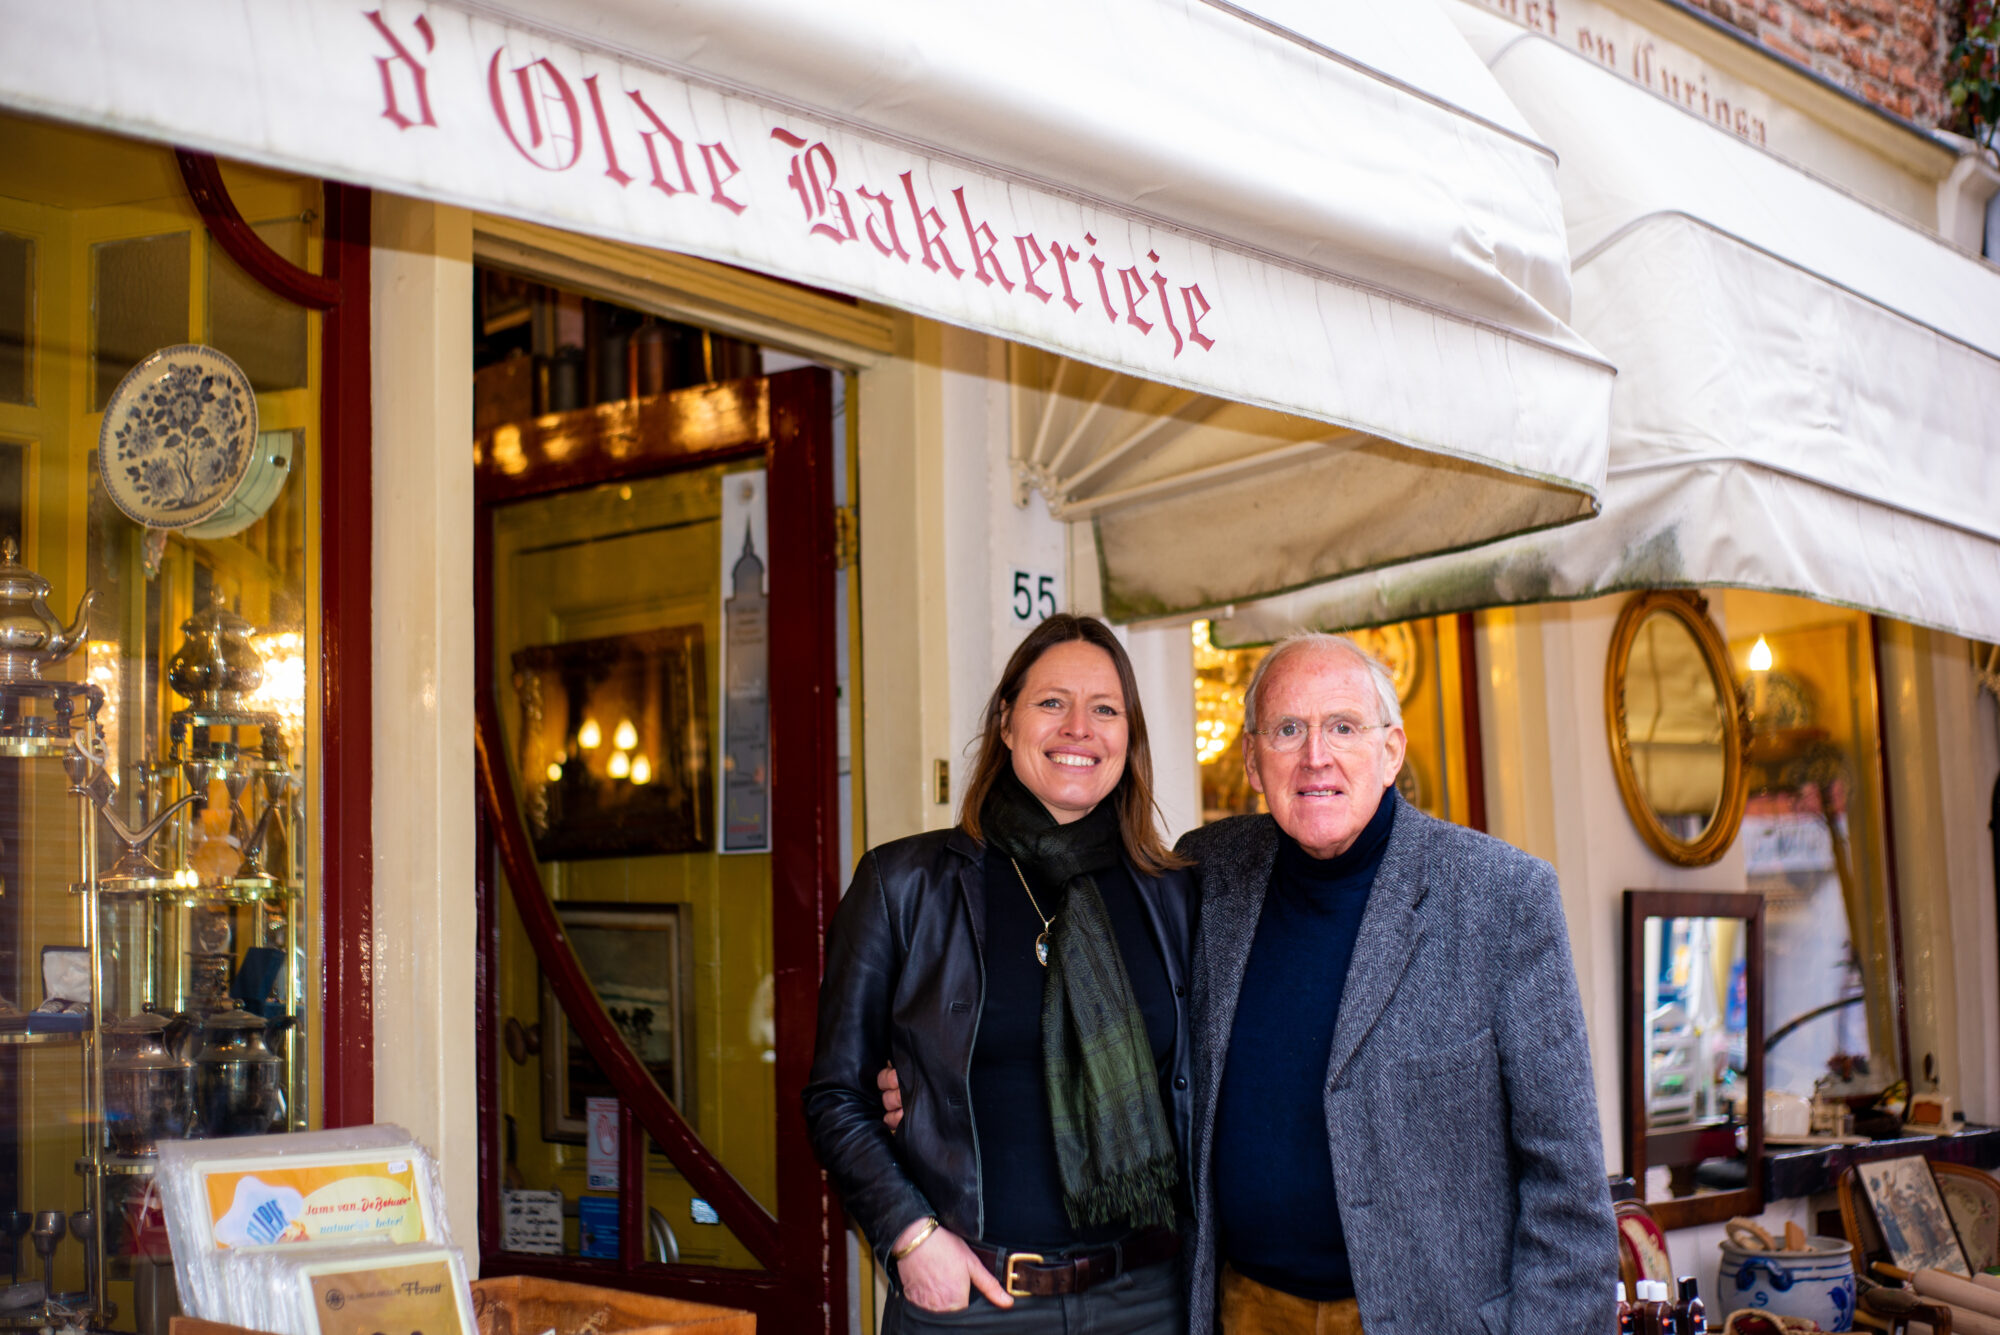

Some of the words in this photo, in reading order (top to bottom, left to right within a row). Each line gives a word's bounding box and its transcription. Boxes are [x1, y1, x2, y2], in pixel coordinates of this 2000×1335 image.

[488, 46, 748, 216] Olde
[771, 127, 1216, 360] Bakkerieje
[1013, 571, 1056, 620] 55
[306, 1204, 334, 1216] Jams
